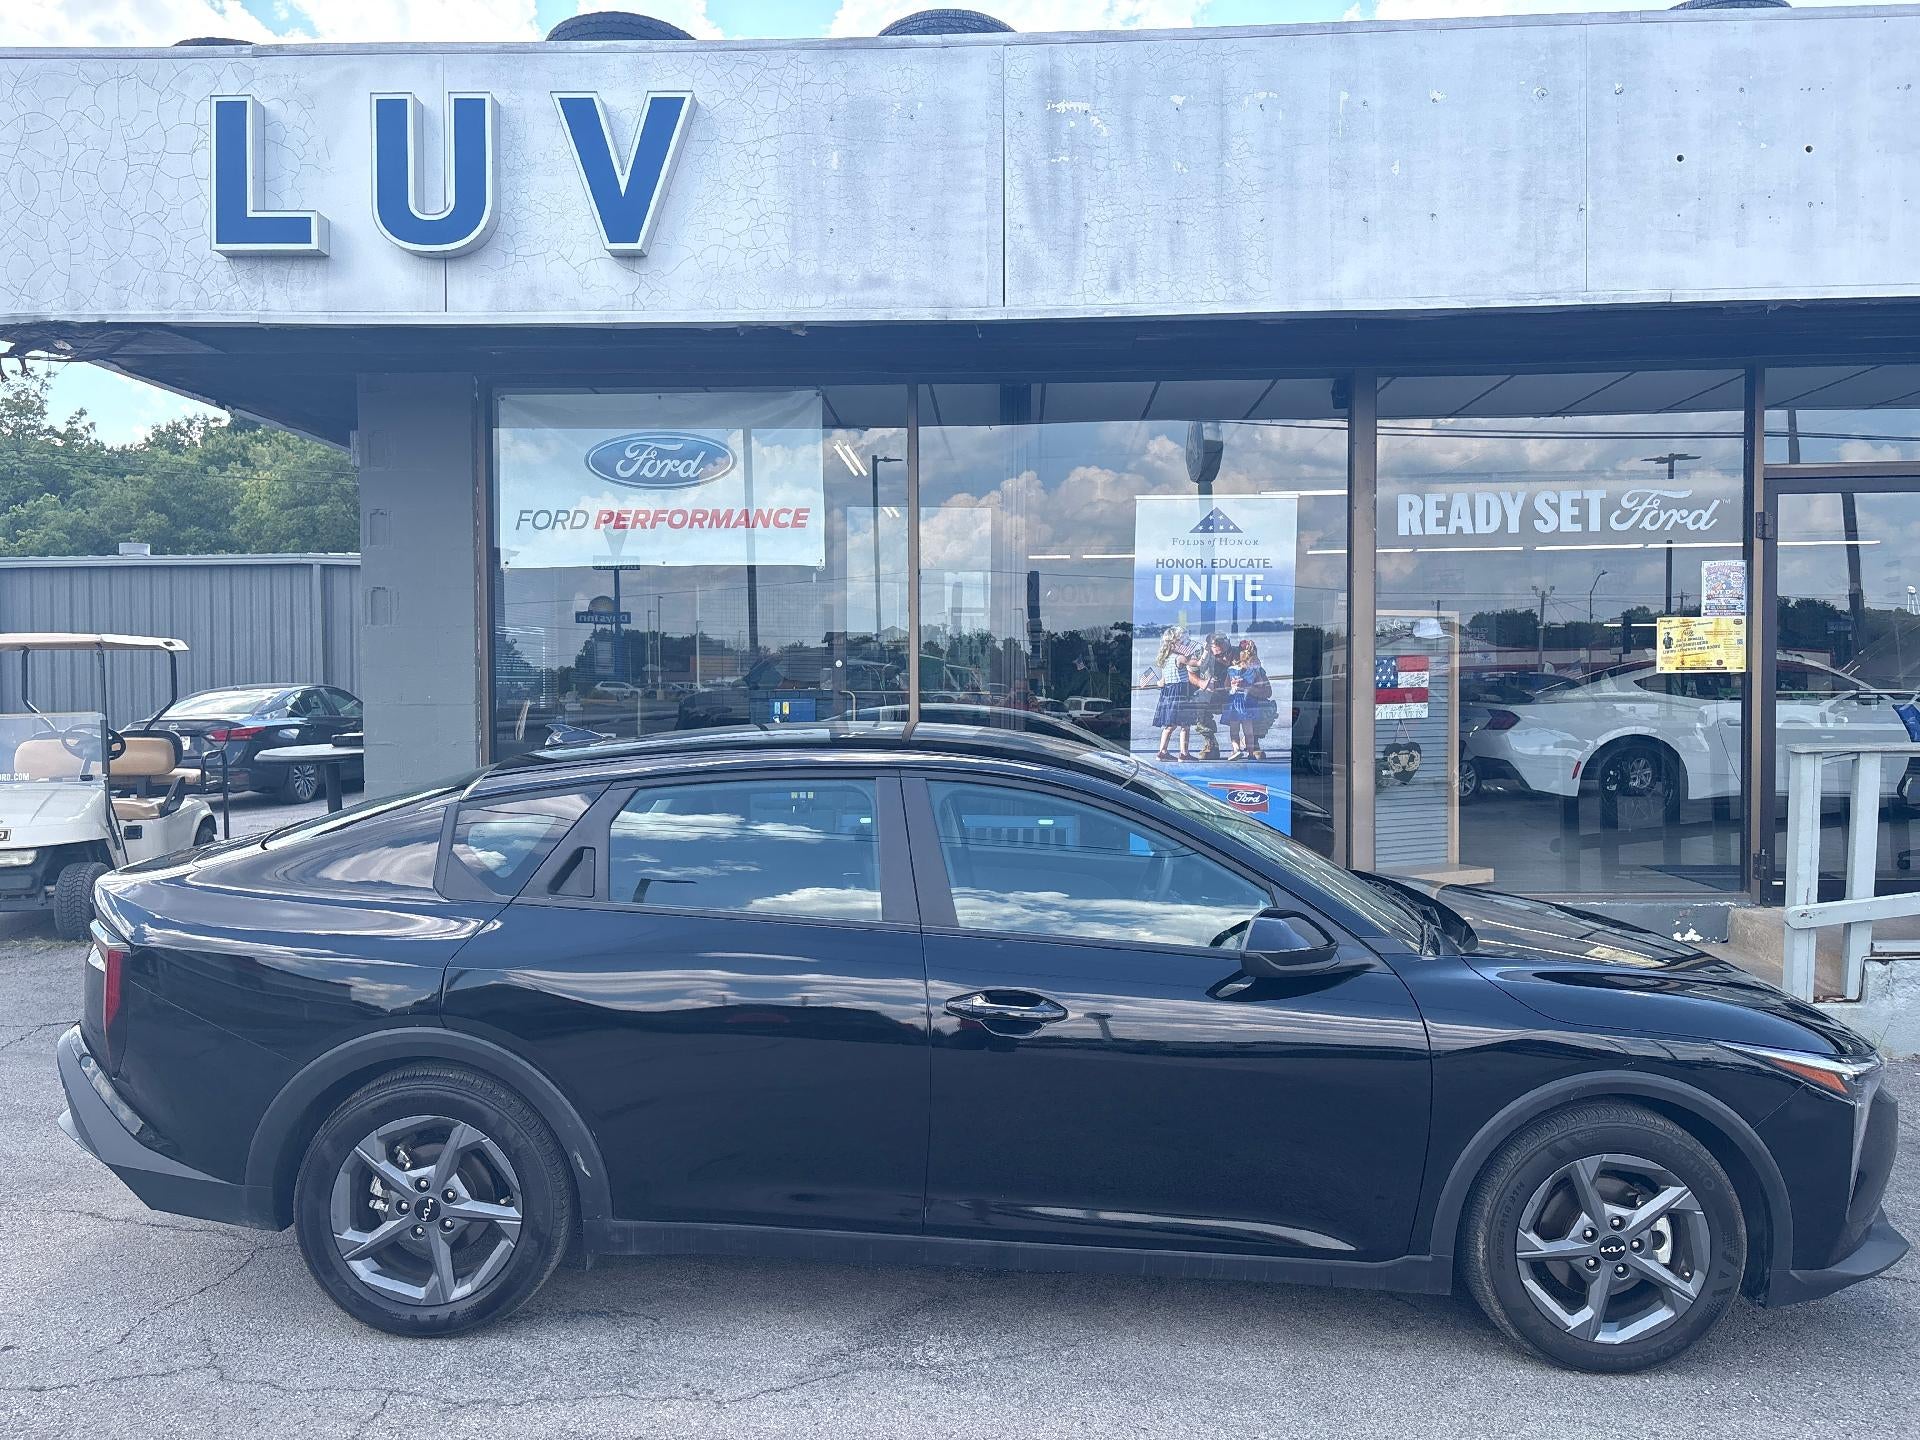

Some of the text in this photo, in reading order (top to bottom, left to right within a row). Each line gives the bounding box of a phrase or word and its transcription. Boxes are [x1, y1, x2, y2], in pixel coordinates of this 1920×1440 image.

[209, 91, 697, 257] LUV
[615, 441, 706, 478] Ford
[515, 507, 810, 531] FORD PERFORMANCE
[1397, 490, 1525, 536] READY
[1533, 489, 1606, 533] SET
[1609, 488, 1719, 531] Ford
[1208, 537, 1216, 547] of
[1155, 558, 1273, 569] HONOR. EDUCATE.
[1155, 574, 1273, 602] UNITE.
[0, 772, 29, 781] RD.COM
[1234, 790, 1261, 803] Ford
